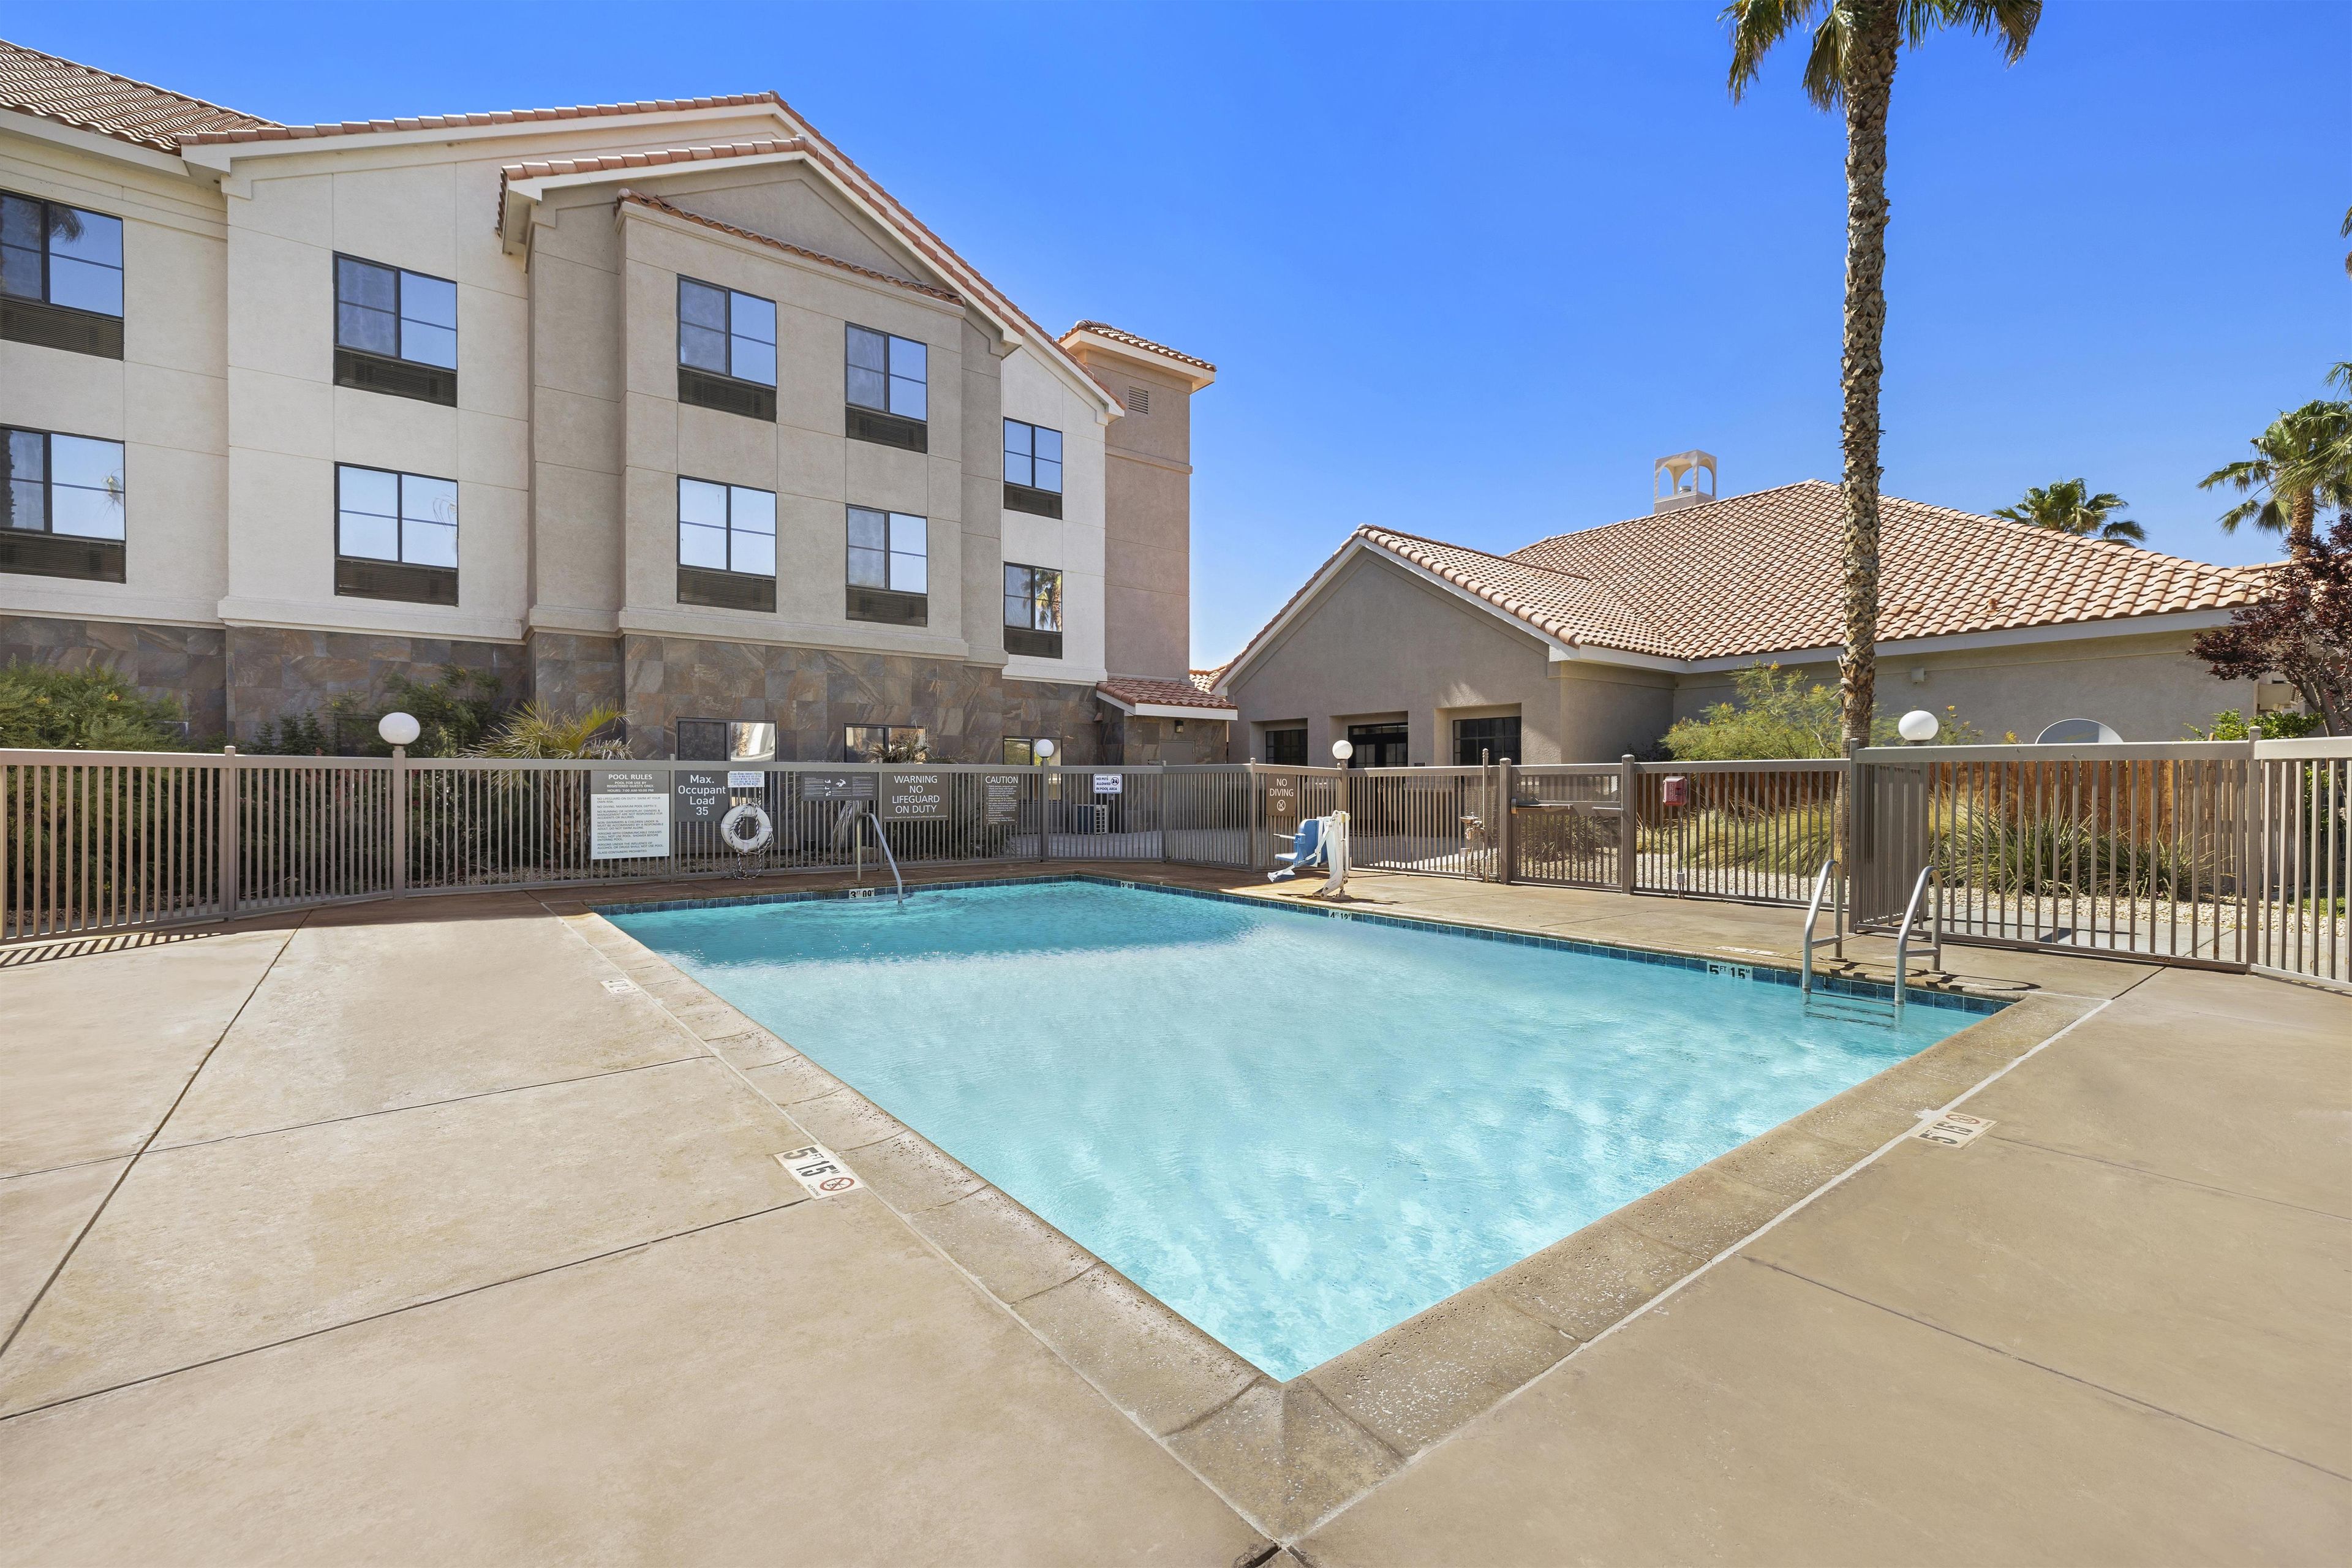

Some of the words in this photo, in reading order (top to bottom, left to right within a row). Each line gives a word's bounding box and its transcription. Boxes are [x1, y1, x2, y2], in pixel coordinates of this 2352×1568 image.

[690, 775, 714, 783] Max.
[678, 785, 726, 796] Occupant
[1270, 788, 1294, 796] DIVING
[690, 796, 715, 805] Load
[892, 795, 940, 803] LIFEGUARD
[696, 807, 709, 815] 35
[912, 805, 937, 813] DUTY
